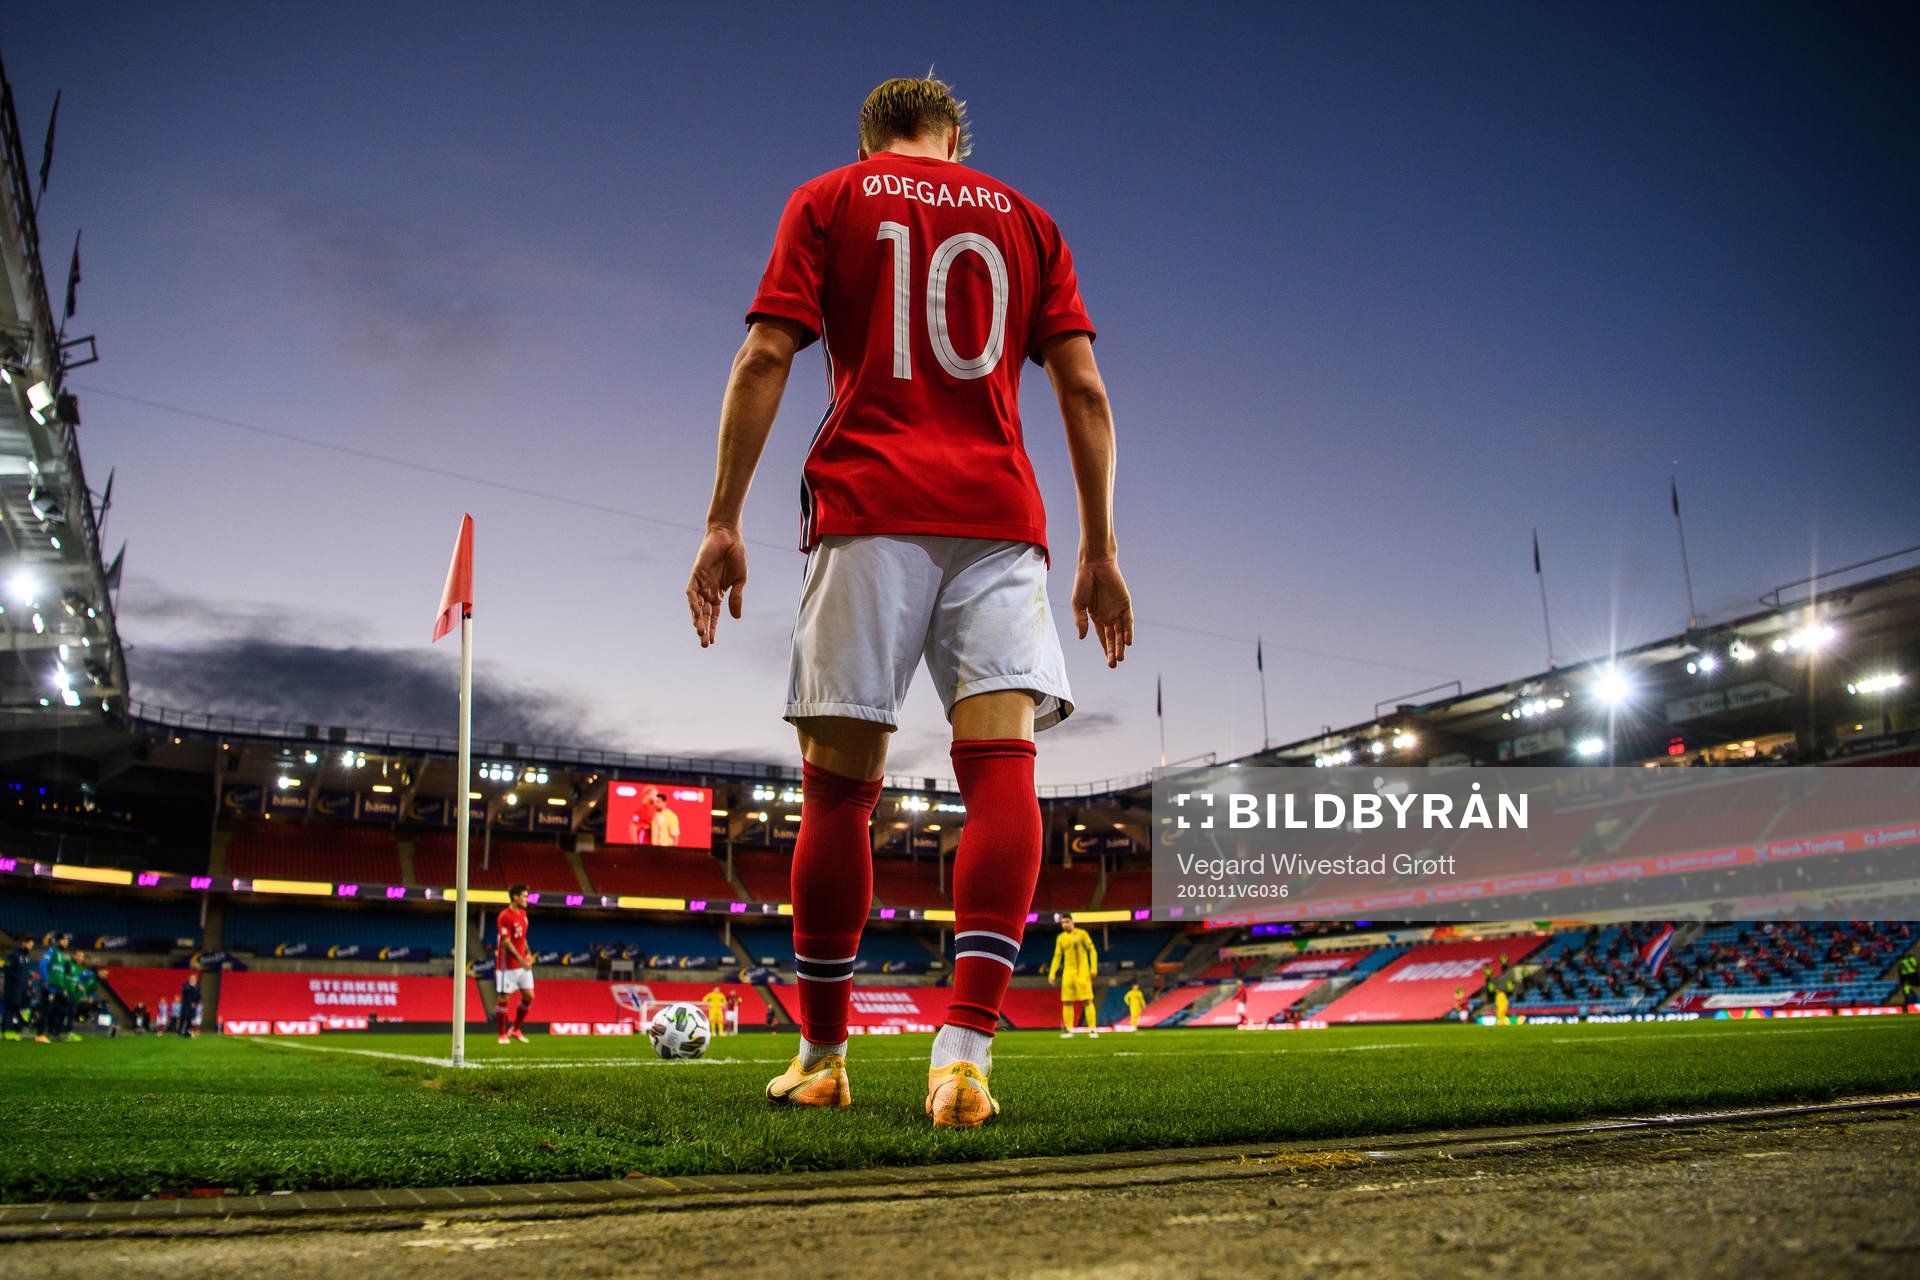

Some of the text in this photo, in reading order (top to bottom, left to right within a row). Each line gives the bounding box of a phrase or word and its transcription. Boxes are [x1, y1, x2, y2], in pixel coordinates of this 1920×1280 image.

[862, 174, 1011, 213] ØDEGAARD
[876, 221, 1009, 380] 10
[1803, 839, 1845, 855] Tipping
[309, 979, 400, 993] STERKERE
[314, 993, 398, 1006] SAMMEN
